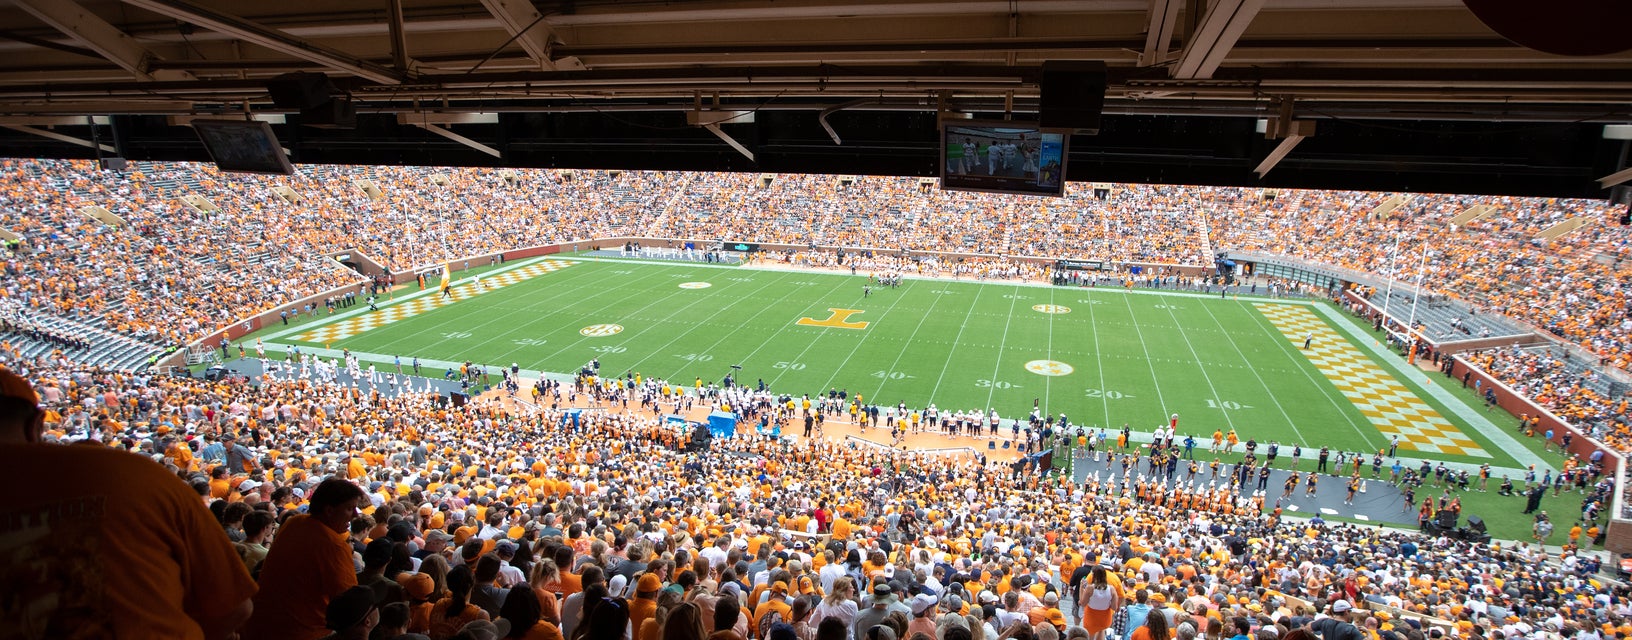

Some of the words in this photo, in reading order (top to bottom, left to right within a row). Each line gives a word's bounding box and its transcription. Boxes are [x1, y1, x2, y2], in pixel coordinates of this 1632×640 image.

[795, 307, 870, 329] T
[772, 361, 807, 371] 50
[870, 370, 906, 380] 40
[975, 379, 1011, 389] 30
[1085, 388, 1122, 399] 20
[1203, 399, 1241, 410] 10
